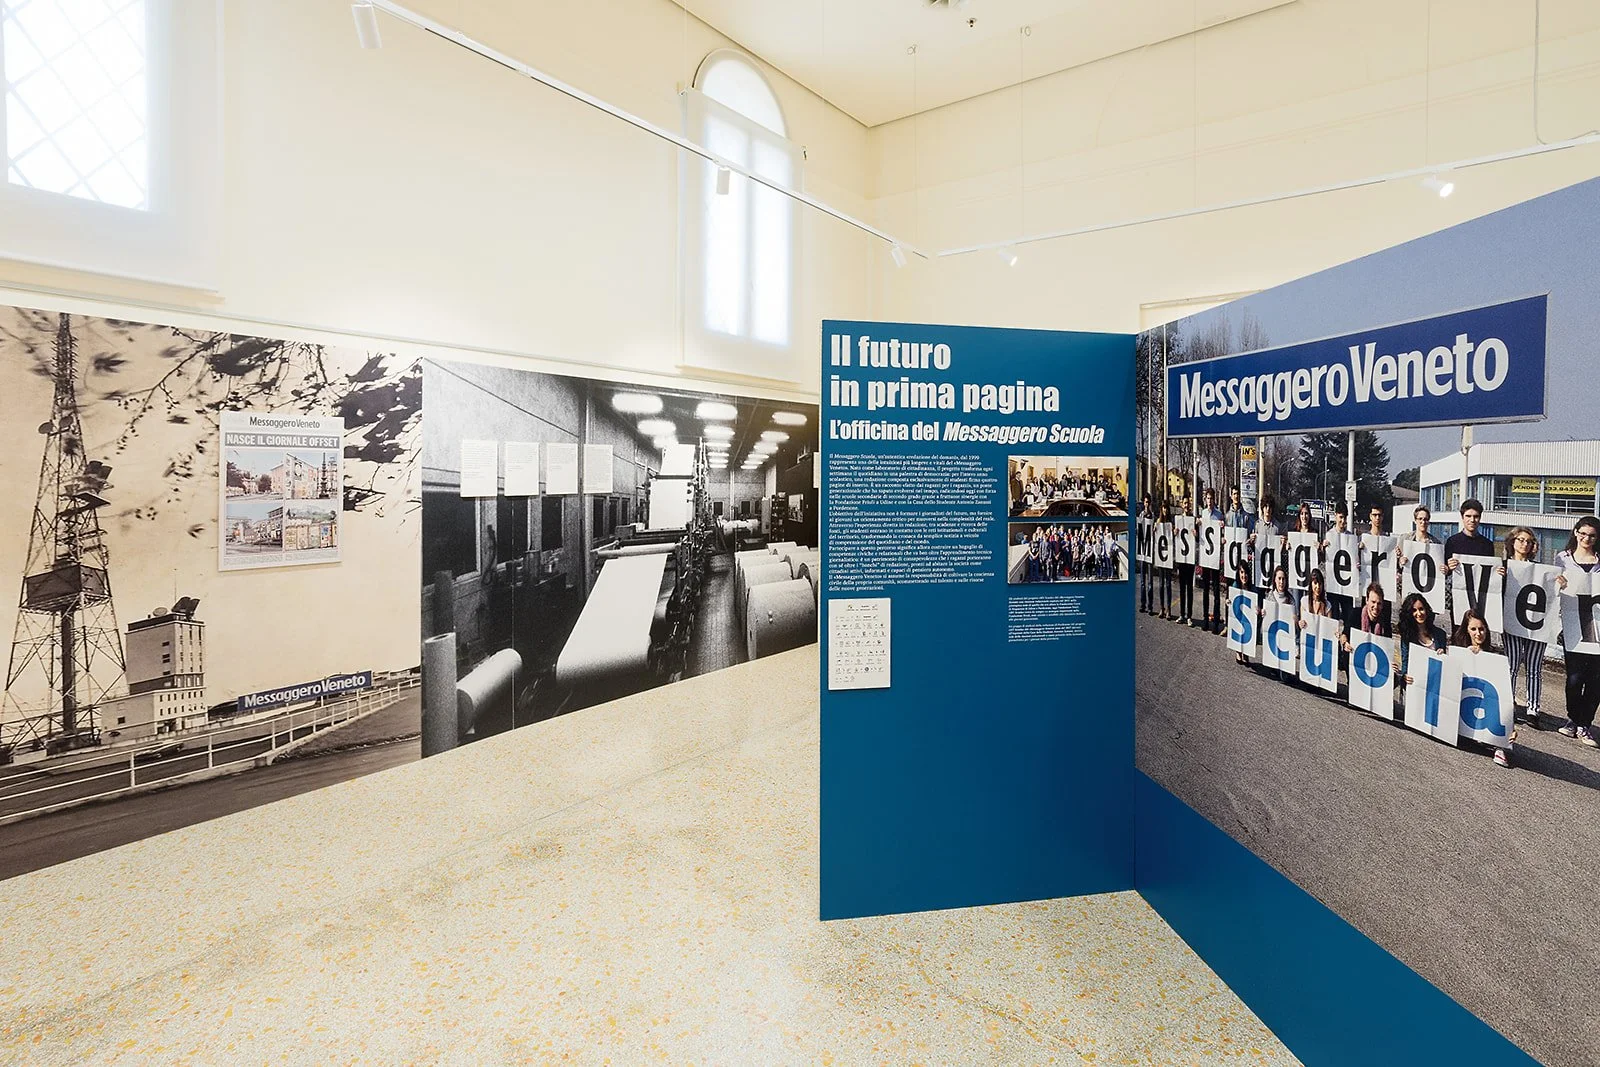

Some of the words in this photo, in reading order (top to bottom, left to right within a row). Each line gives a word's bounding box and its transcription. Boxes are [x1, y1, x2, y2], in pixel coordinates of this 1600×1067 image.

[830, 334, 851, 366] Il
[858, 336, 951, 370] futuro
[830, 375, 860, 407] in
[867, 377, 956, 411] prima
[962, 380, 1060, 415] pagina
[1179, 333, 1509, 422] MessaggeroVeneto
[226, 434, 255, 445] NASCE
[257, 436, 266, 445] IL
[266, 436, 307, 447] GIORNALE
[309, 437, 338, 447] OFFSET
[829, 419, 909, 440] L'officina
[911, 420, 939, 441] del
[942, 421, 1047, 444] Messaggero
[1048, 423, 1105, 444] Scuola
[1231, 594, 1506, 737] Scuola
[244, 675, 365, 708] MessaggeroVeneto
